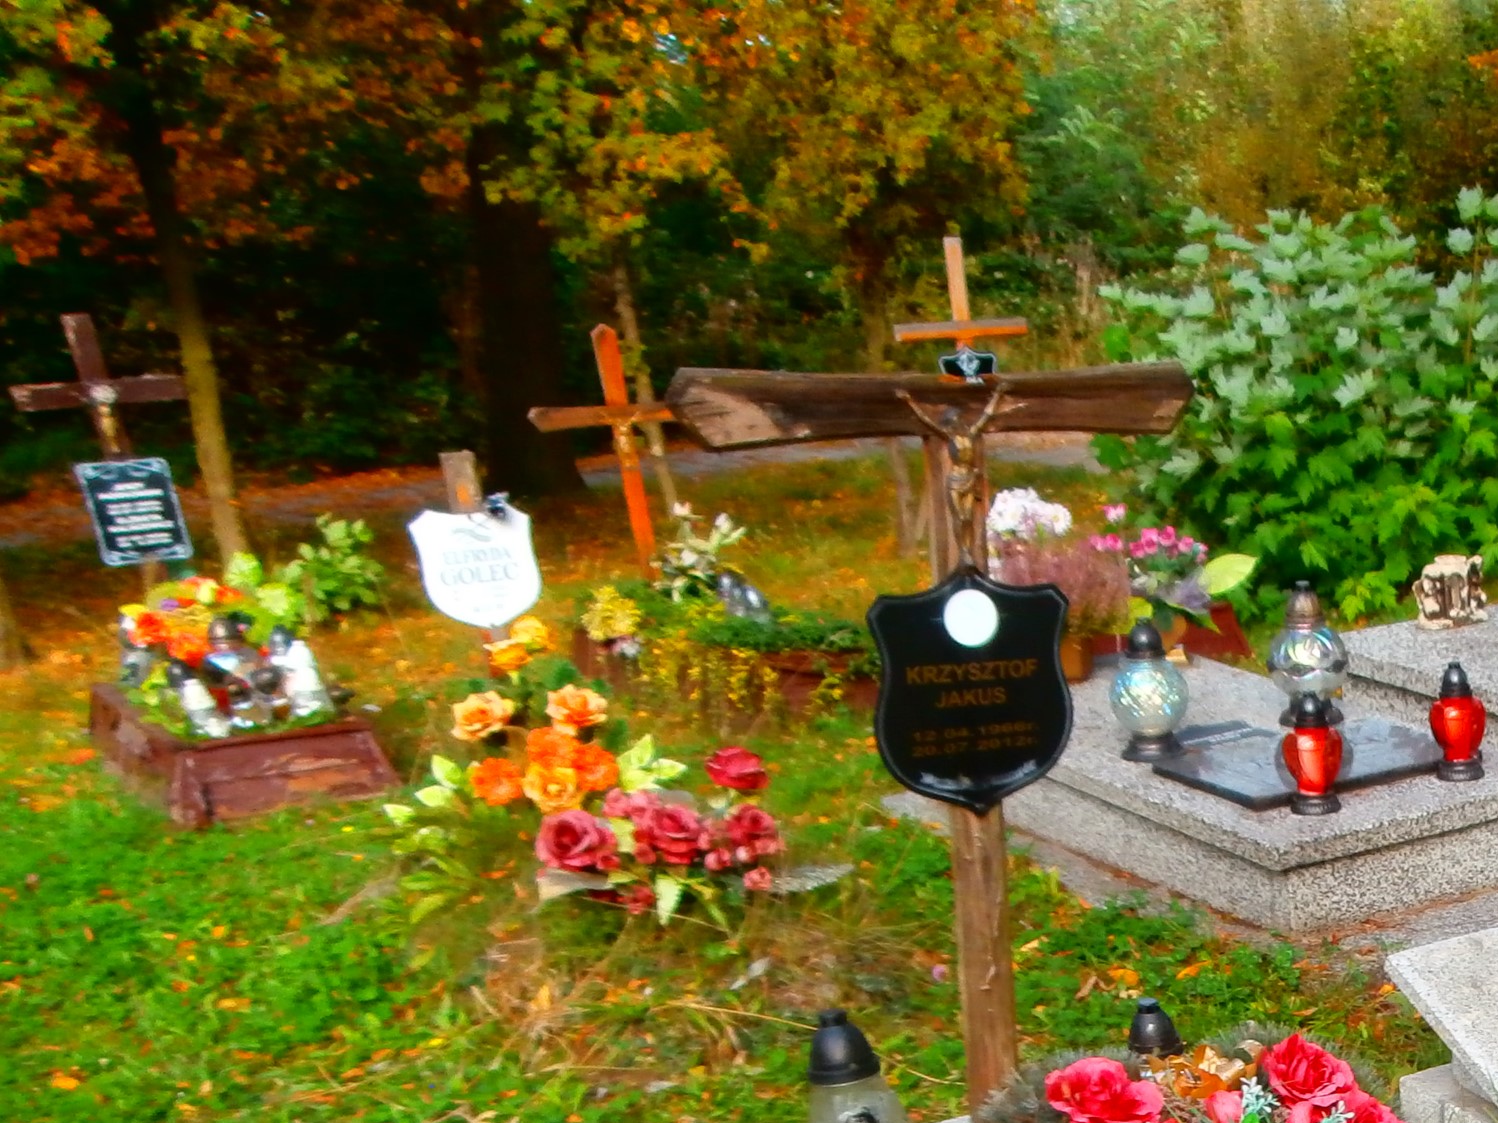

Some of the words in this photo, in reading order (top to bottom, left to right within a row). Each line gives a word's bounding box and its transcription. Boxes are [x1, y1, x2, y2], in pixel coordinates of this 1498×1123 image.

[441, 562, 519, 586] GOLEC
[906, 658, 1038, 684] KRZYSZTOF
[936, 687, 1007, 708] JAKUS
